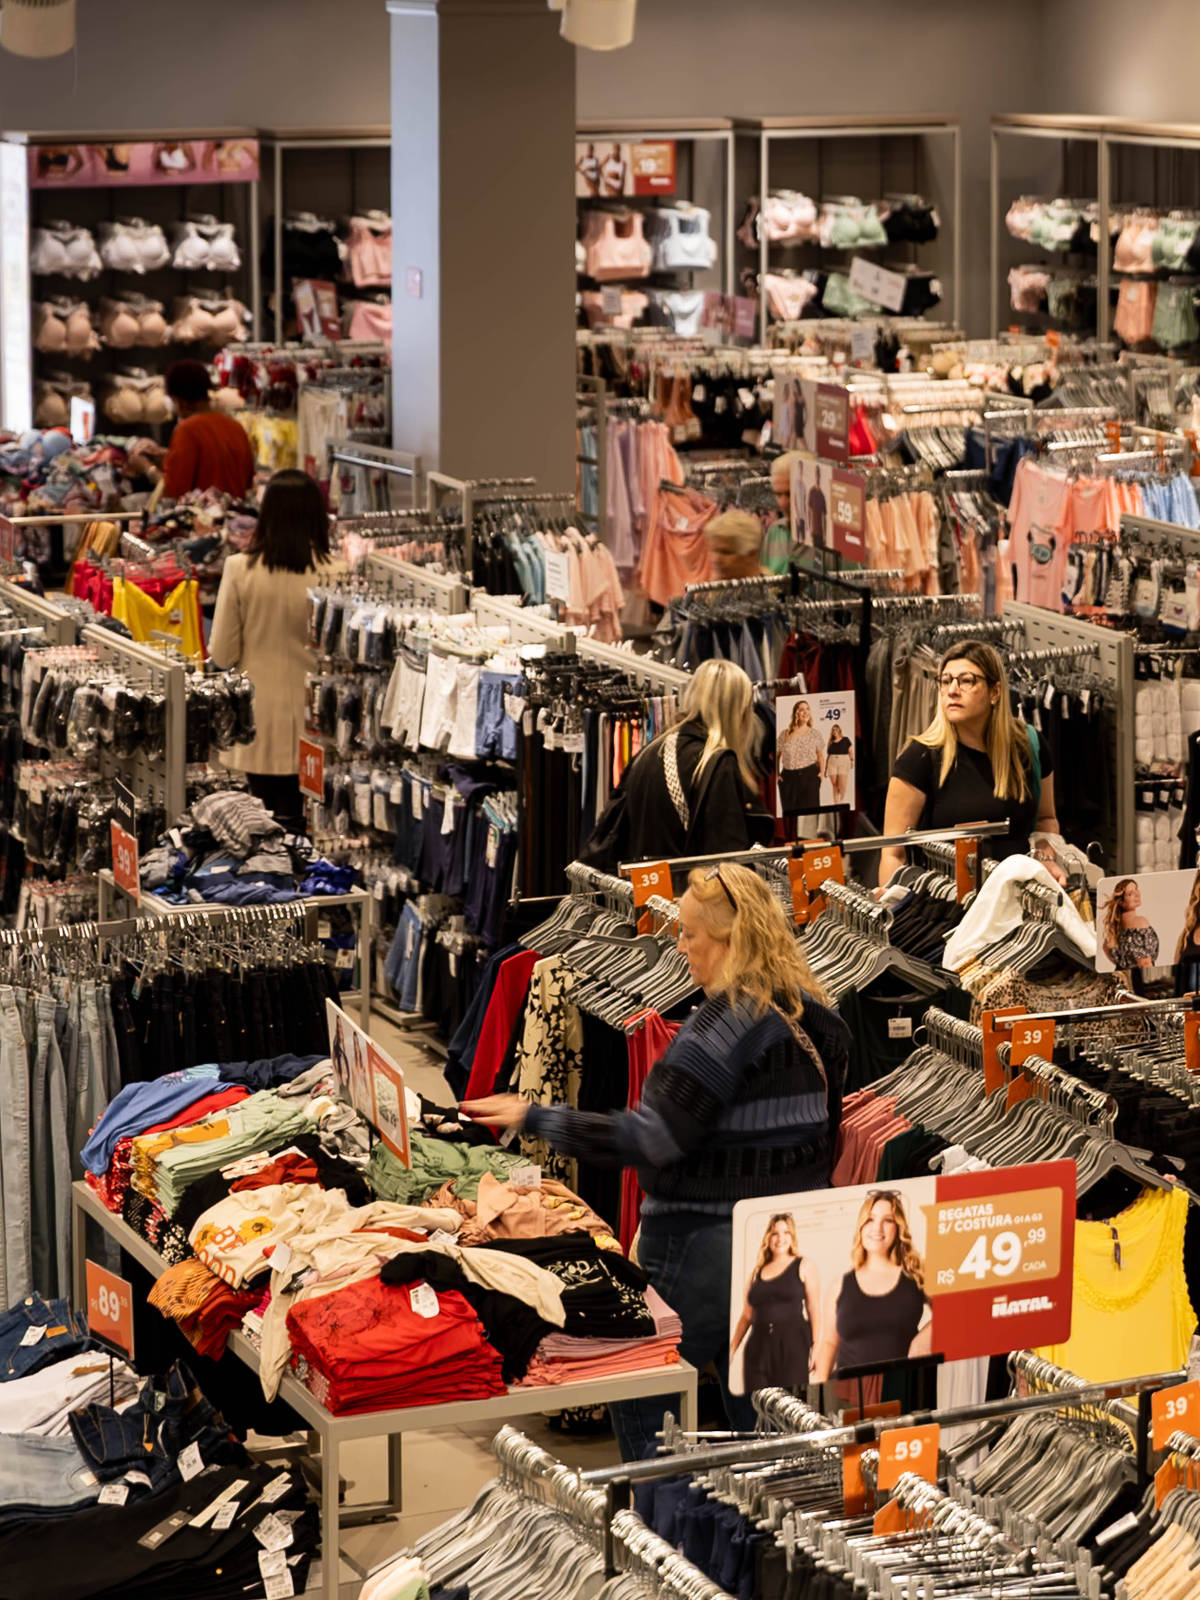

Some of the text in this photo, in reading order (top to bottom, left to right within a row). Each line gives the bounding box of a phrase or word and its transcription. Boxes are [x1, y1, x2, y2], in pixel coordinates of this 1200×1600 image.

[825, 708, 841, 721] 49
[813, 856, 831, 870] 59
[641, 872, 659, 887] 39
[1024, 1029, 1042, 1044] 39
[938, 1203, 993, 1221] REGATAS
[938, 1221, 951, 1235] S/
[954, 1214, 1012, 1232] COSTURA
[937, 1268, 955, 1285] R$
[957, 1231, 1022, 1280] 49
[1022, 1260, 1046, 1272] CADA
[99, 1285, 119, 1322] 89
[992, 1296, 1053, 1318] NATAL
[1166, 1397, 1187, 1419] 39
[895, 1439, 922, 1460] 59
